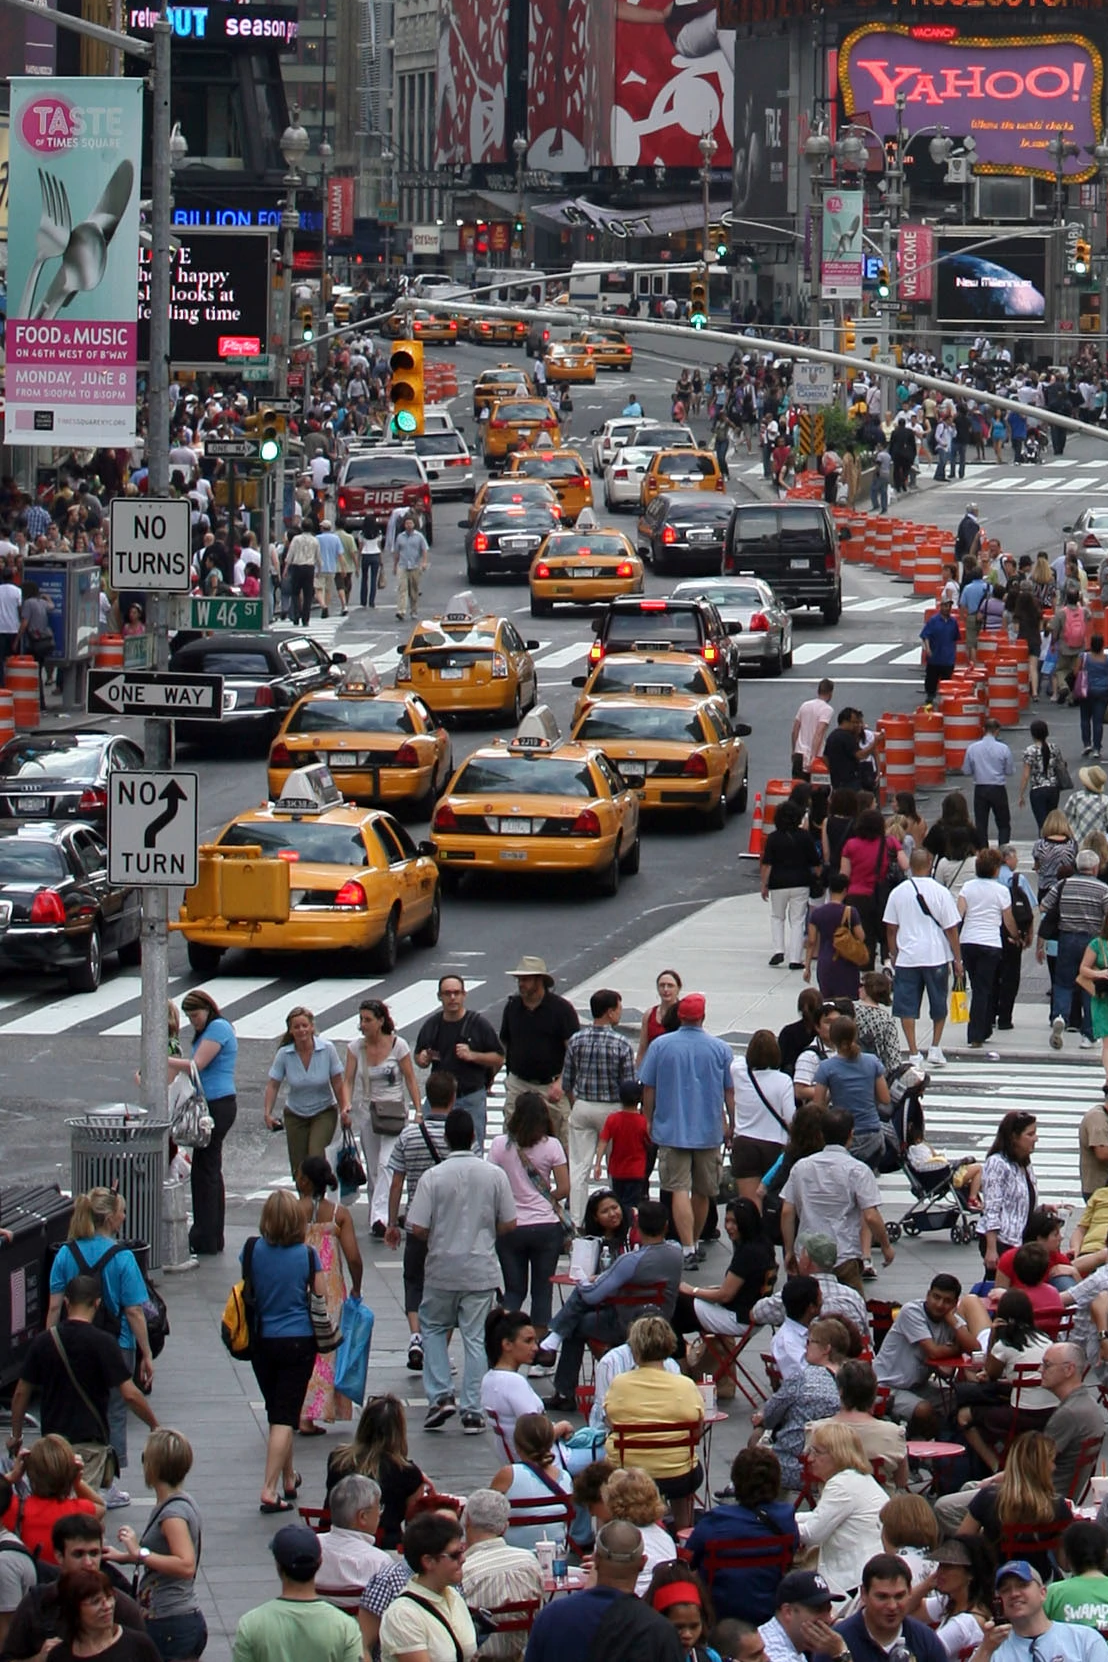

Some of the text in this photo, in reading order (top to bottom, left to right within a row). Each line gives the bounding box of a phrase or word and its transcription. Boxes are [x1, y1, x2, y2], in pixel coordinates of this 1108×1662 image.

[226, 17, 286, 36] season
[912, 27, 956, 37] VACANCY
[857, 60, 1086, 106] YAHOO!
[33, 106, 123, 135] TASTE
[46, 138, 79, 148] TIMES
[81, 138, 121, 148] SQUARE
[174, 210, 251, 226] BILLION
[332, 185, 342, 234] JAMJAM
[904, 231, 917, 296] WELCOME
[178, 269, 230, 288] happy
[172, 286, 234, 302] looks at
[205, 305, 241, 321] time
[16, 326, 61, 345] FOOD
[74, 328, 128, 345] MUSIC
[16, 349, 29, 358] ON
[32, 349, 54, 359] 46TH
[58, 350, 83, 359] WEST
[86, 350, 98, 359] OF
[16, 369, 127, 387] MONDAY, JUNE 8
[15, 388, 42, 398] FROM
[80, 390, 91, 399] TO
[212, 444, 253, 455] ONE WAY
[364, 491, 404, 505] FIRE
[134, 515, 167, 539] NO
[115, 552, 185, 575] TURNS
[197, 602, 258, 626] W 46 ST
[108, 685, 204, 704] ONE WAY
[119, 781, 156, 805] NO
[122, 853, 184, 874] TURN
